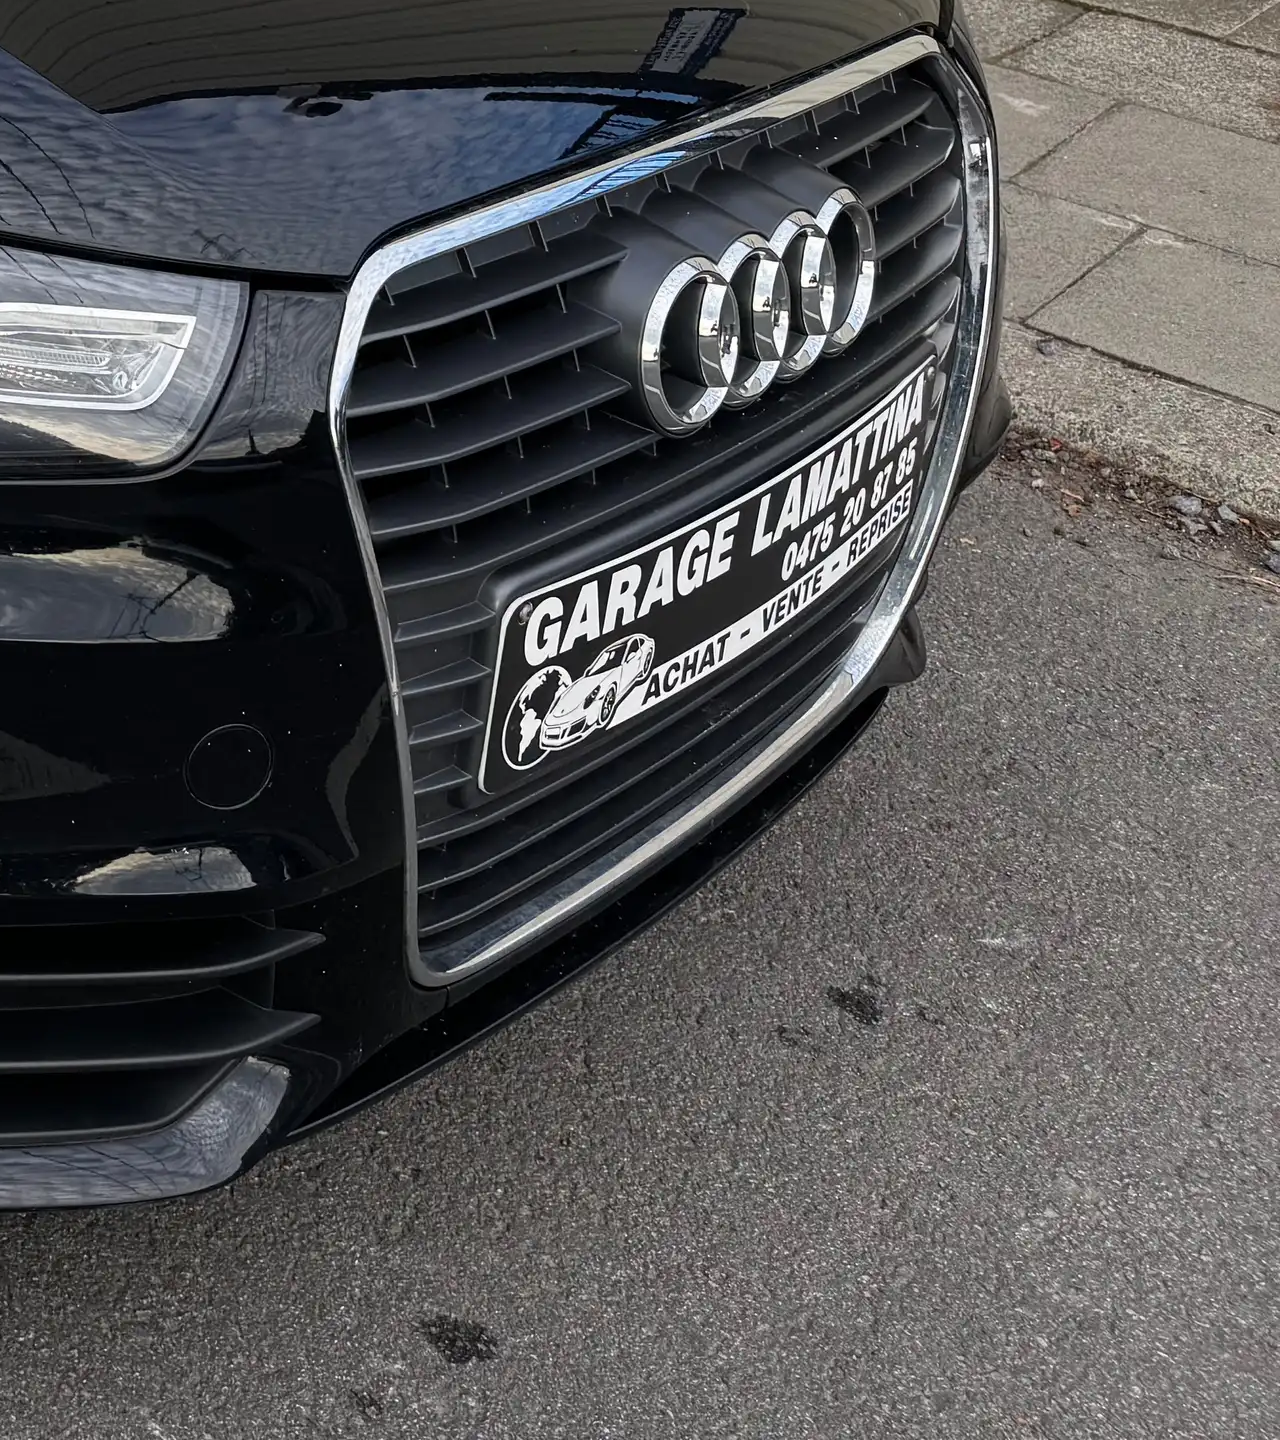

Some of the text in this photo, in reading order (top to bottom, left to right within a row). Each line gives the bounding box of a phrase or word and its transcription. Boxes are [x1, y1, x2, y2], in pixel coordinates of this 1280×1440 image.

[525, 377, 923, 666] GARAGE LAMATTINA
[642, 633, 732, 707] ACHAT
[761, 571, 824, 627] VENTE
[847, 487, 912, 566] REPRISE
[781, 441, 917, 583] 0475 20 87 85
